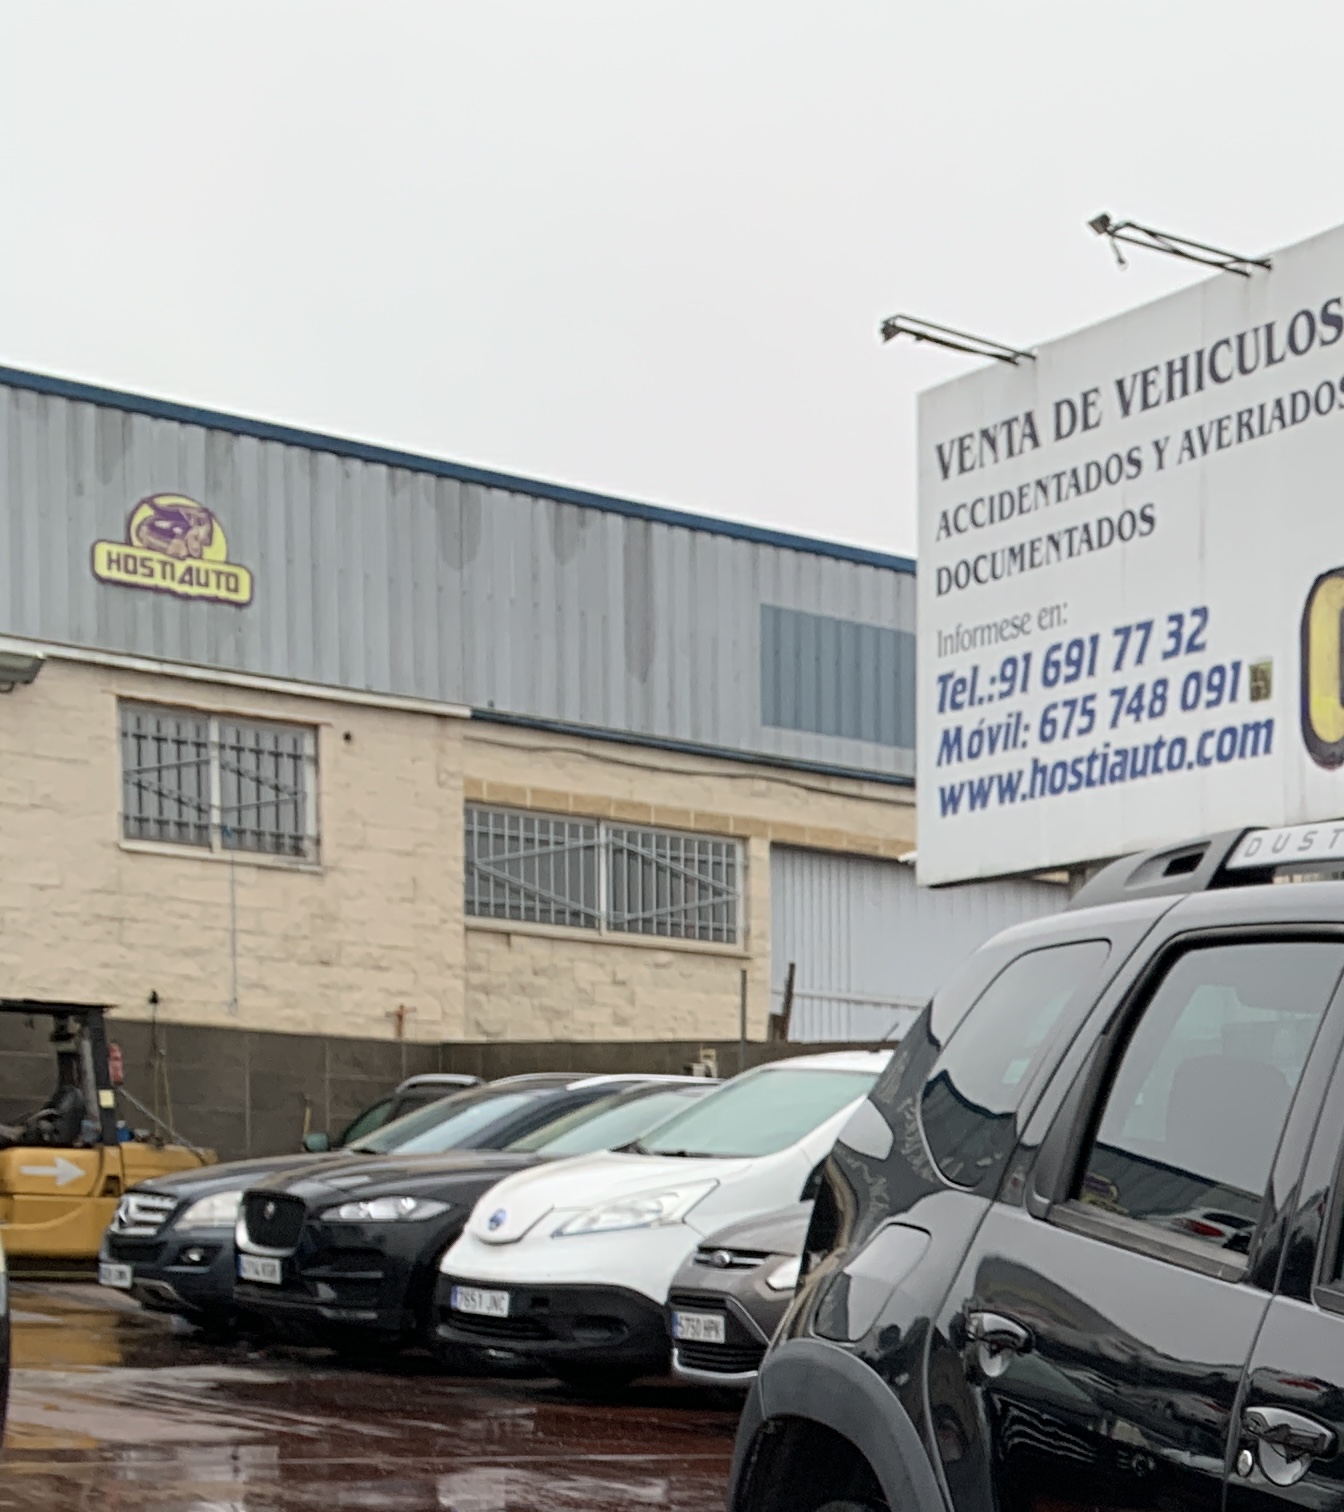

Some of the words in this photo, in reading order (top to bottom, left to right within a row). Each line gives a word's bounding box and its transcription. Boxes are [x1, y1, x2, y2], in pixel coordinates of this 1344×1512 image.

[935, 411, 1041, 481] VENTA
[1052, 387, 1103, 443] DE
[935, 446, 1143, 543] ACCIDENTADOS
[1150, 437, 1170, 471] Y
[106, 549, 239, 593] HOSTIAUTO
[935, 503, 1157, 597] DOCUMENTADOS
[1037, 601, 1069, 633] en:
[1040, 633, 1100, 689] 691
[1112, 618, 1155, 674] 77
[1161, 605, 1210, 661] 32
[936, 710, 1031, 768] Móvil:
[1038, 692, 1097, 745] 675
[1109, 676, 1169, 730] 748
[1180, 660, 1243, 712] 091
[938, 717, 1275, 819] www.hostiauto.com
